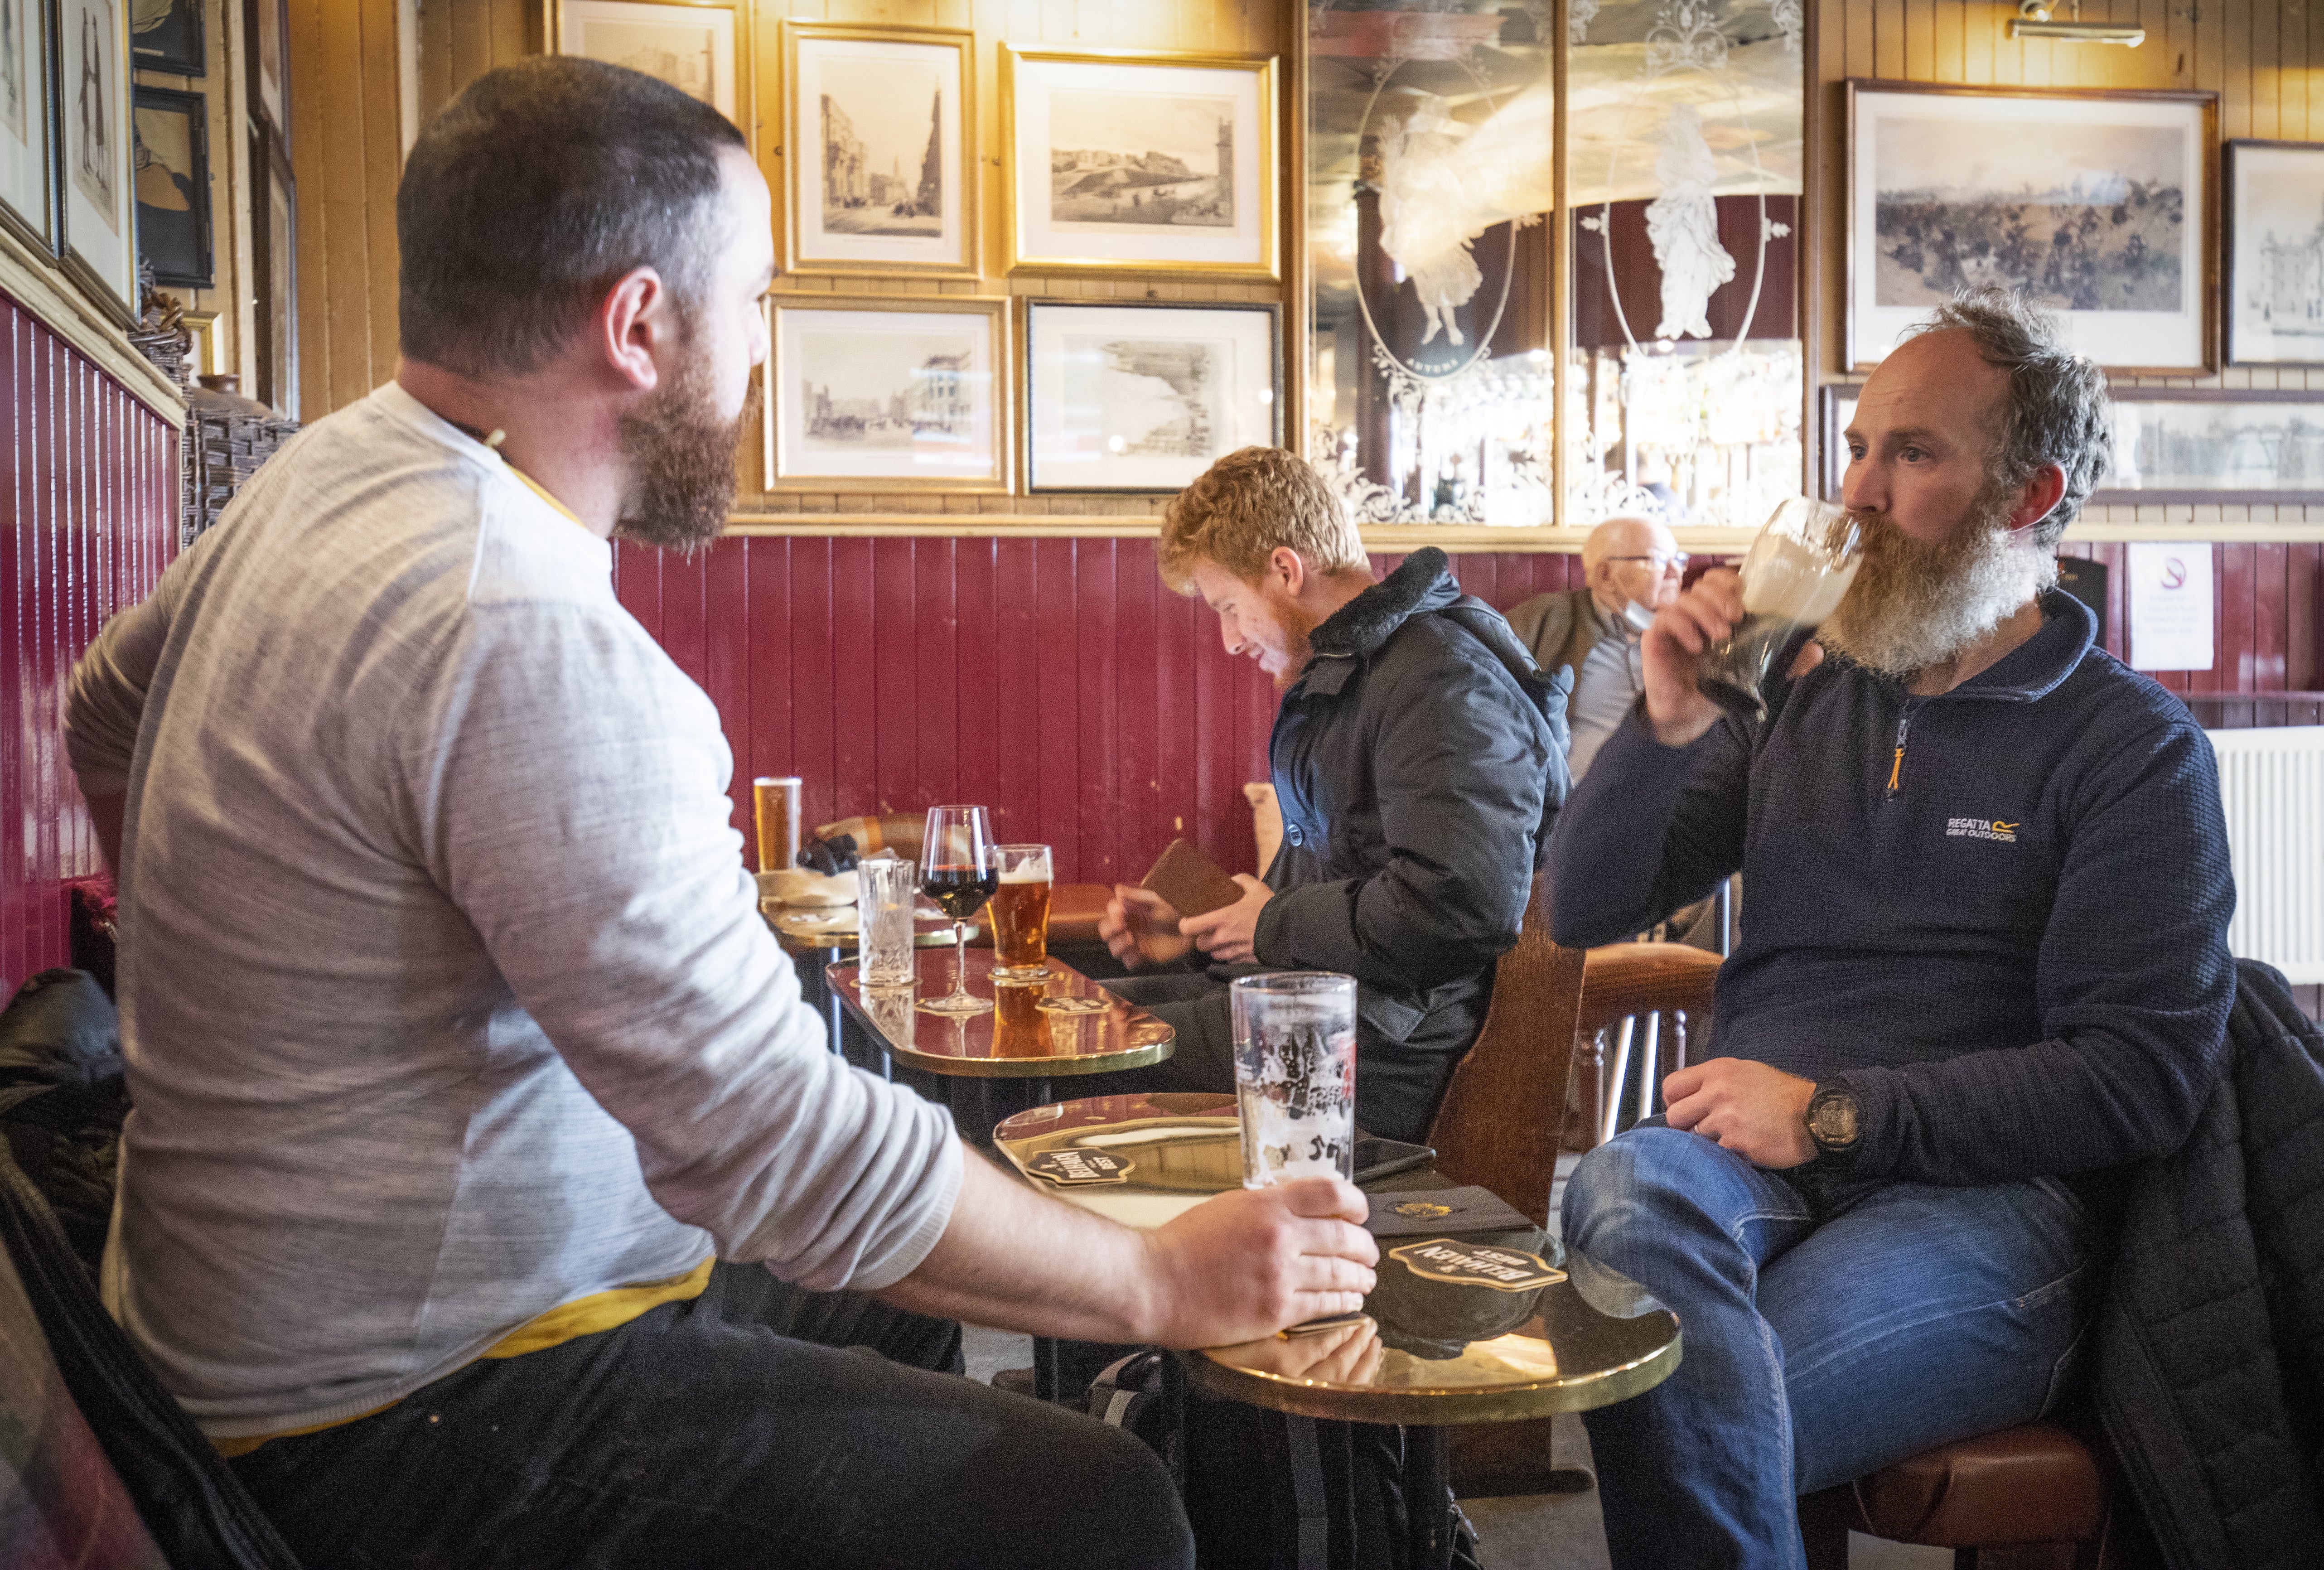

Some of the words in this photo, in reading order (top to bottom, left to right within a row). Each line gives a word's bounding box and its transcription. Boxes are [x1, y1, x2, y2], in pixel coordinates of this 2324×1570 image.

[1406, 357, 1459, 374] AUTUMN
[1948, 818, 1991, 831] REGATTA
[1968, 830, 2016, 842] OUTDOORS
[1473, 1249, 1528, 1266] BEST
